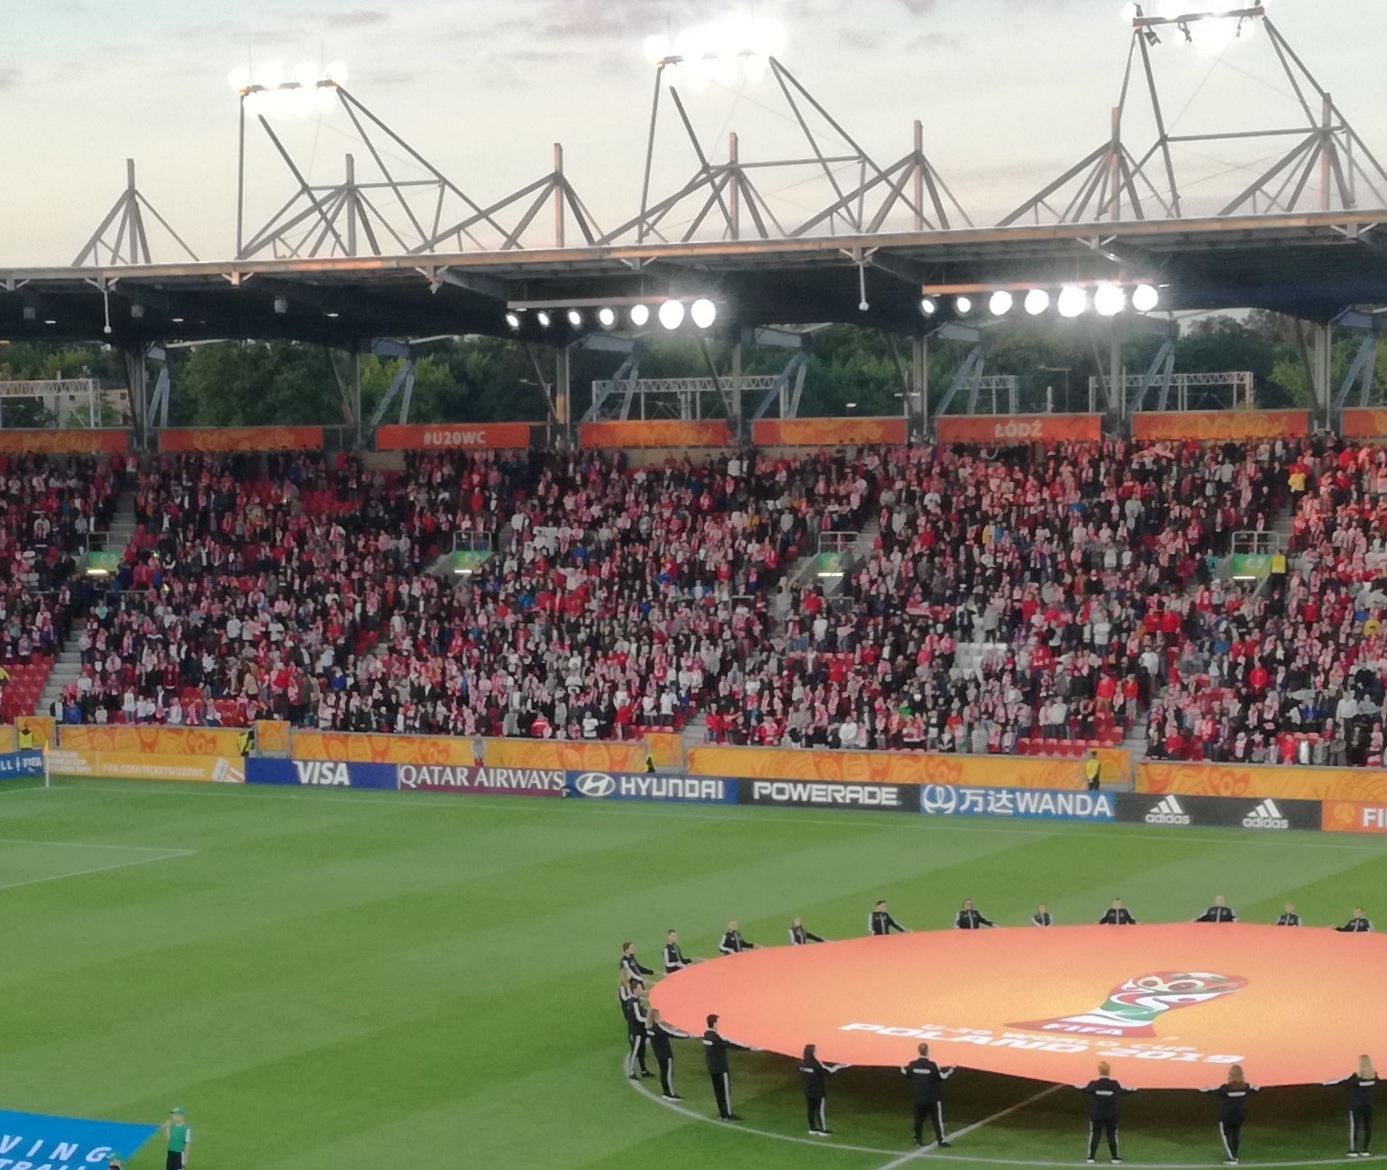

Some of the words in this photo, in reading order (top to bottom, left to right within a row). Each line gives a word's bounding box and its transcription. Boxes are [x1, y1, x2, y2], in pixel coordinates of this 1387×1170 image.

[423, 430, 486, 446] #U20WC
[994, 419, 1042, 438] ŁÓDŹ
[292, 761, 350, 786] VISA
[400, 765, 471, 789] QATAR
[475, 766, 565, 791] AIRWAYS
[620, 777, 724, 799] HYUNDAI
[753, 781, 899, 805] POWERADE
[1015, 790, 1112, 818] WANDA
[1145, 810, 1191, 825] adidas
[1243, 815, 1289, 829] adidas
[1041, 1023, 1123, 1036] FIFA
[838, 1022, 1091, 1054] POLAND
[1095, 1047, 1246, 1064] 2019
[1001, 1032, 1120, 1047] WORLD
[1130, 1043, 1198, 1052] CUP
